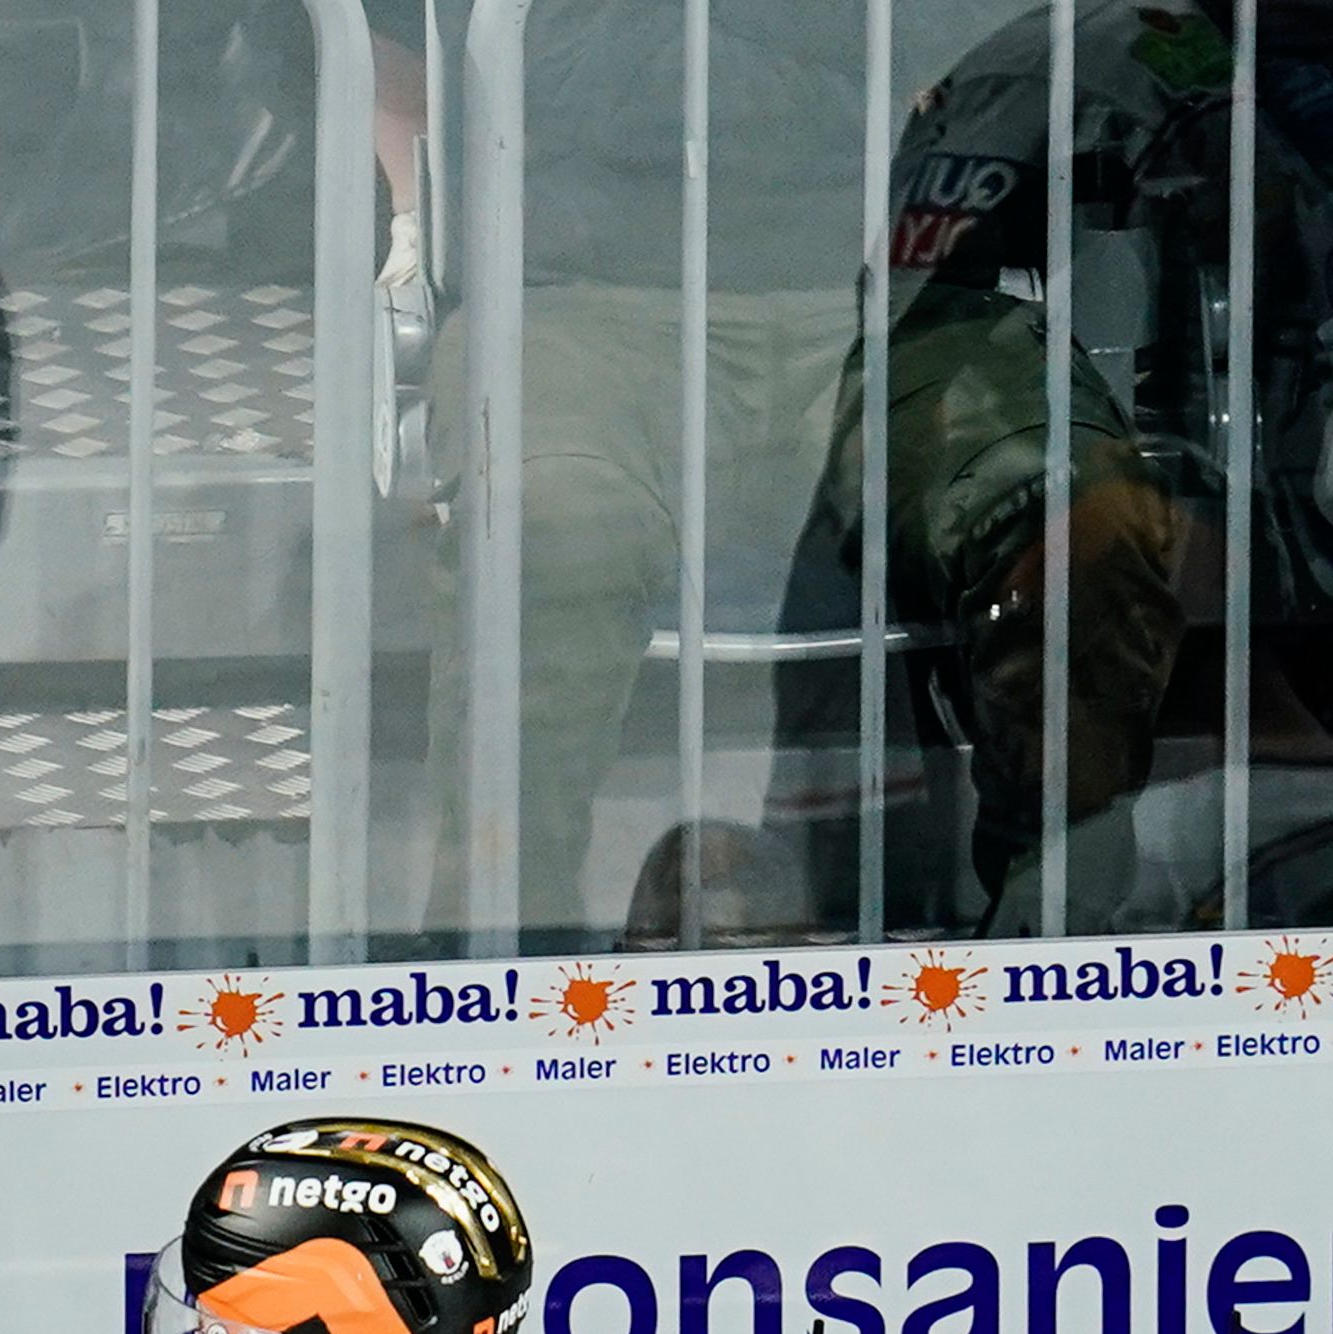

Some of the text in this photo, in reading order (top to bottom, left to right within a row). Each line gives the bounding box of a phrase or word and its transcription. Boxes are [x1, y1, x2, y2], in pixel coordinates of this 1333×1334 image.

[297, 969, 520, 1029] maba!
[651, 957, 872, 1016] maba!
[1003, 944, 1225, 1003] maba!
[96, 1074, 201, 1099] Elektro
[251, 1068, 331, 1092] Maler
[381, 1062, 486, 1087] Elektro
[536, 1056, 617, 1080] Maler
[666, 1050, 771, 1076] Elektro
[820, 1046, 901, 1071] Maler
[950, 1042, 1055, 1067] Elektro
[1104, 1037, 1185, 1062] Maler
[1217, 1032, 1321, 1057] Elektro
[269, 1175, 397, 1214] netgo
[395, 1140, 500, 1233] netgo
